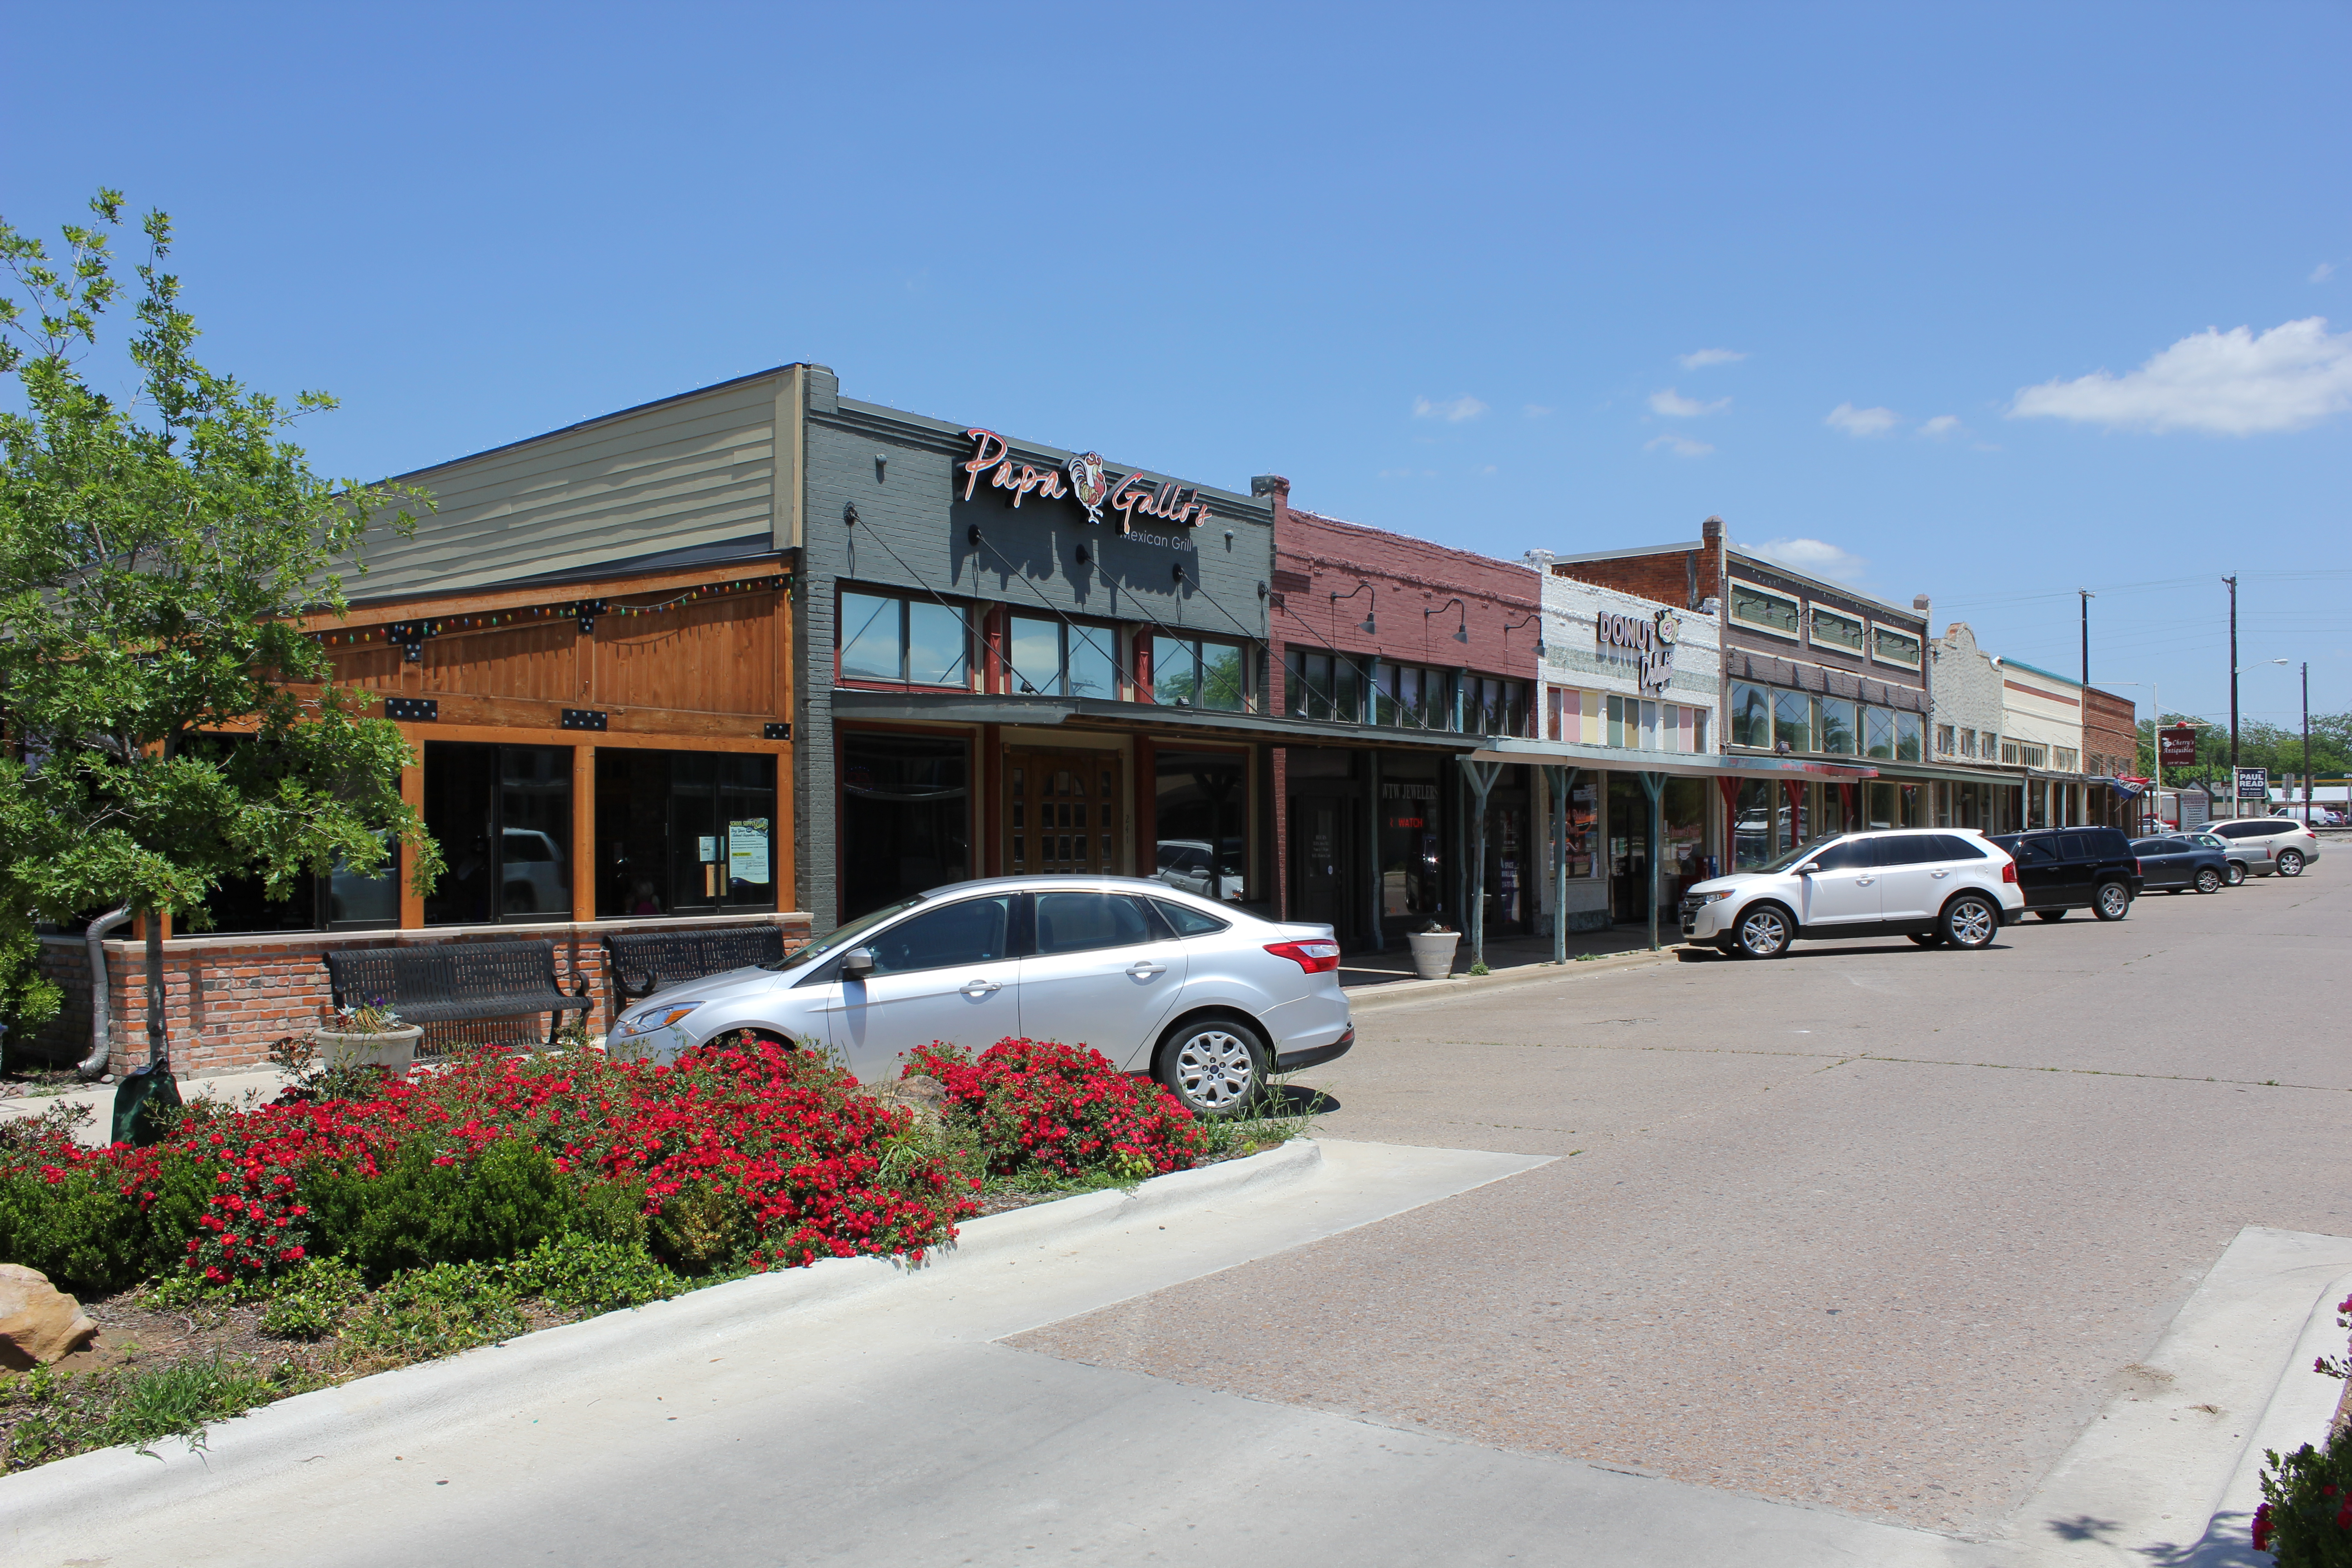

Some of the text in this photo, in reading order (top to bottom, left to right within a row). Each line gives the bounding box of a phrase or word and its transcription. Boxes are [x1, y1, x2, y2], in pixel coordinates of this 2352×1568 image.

[965, 428, 1213, 534] Papa Gallo's
[1171, 536, 1192, 552] Grill
[1600, 611, 1656, 652] DONUT
[1641, 652, 1674, 691] Delight
[2163, 745, 2194, 755] Antiquibles
[1402, 784, 1438, 800] JEWELERS
[1398, 817, 1424, 828] WATCH
